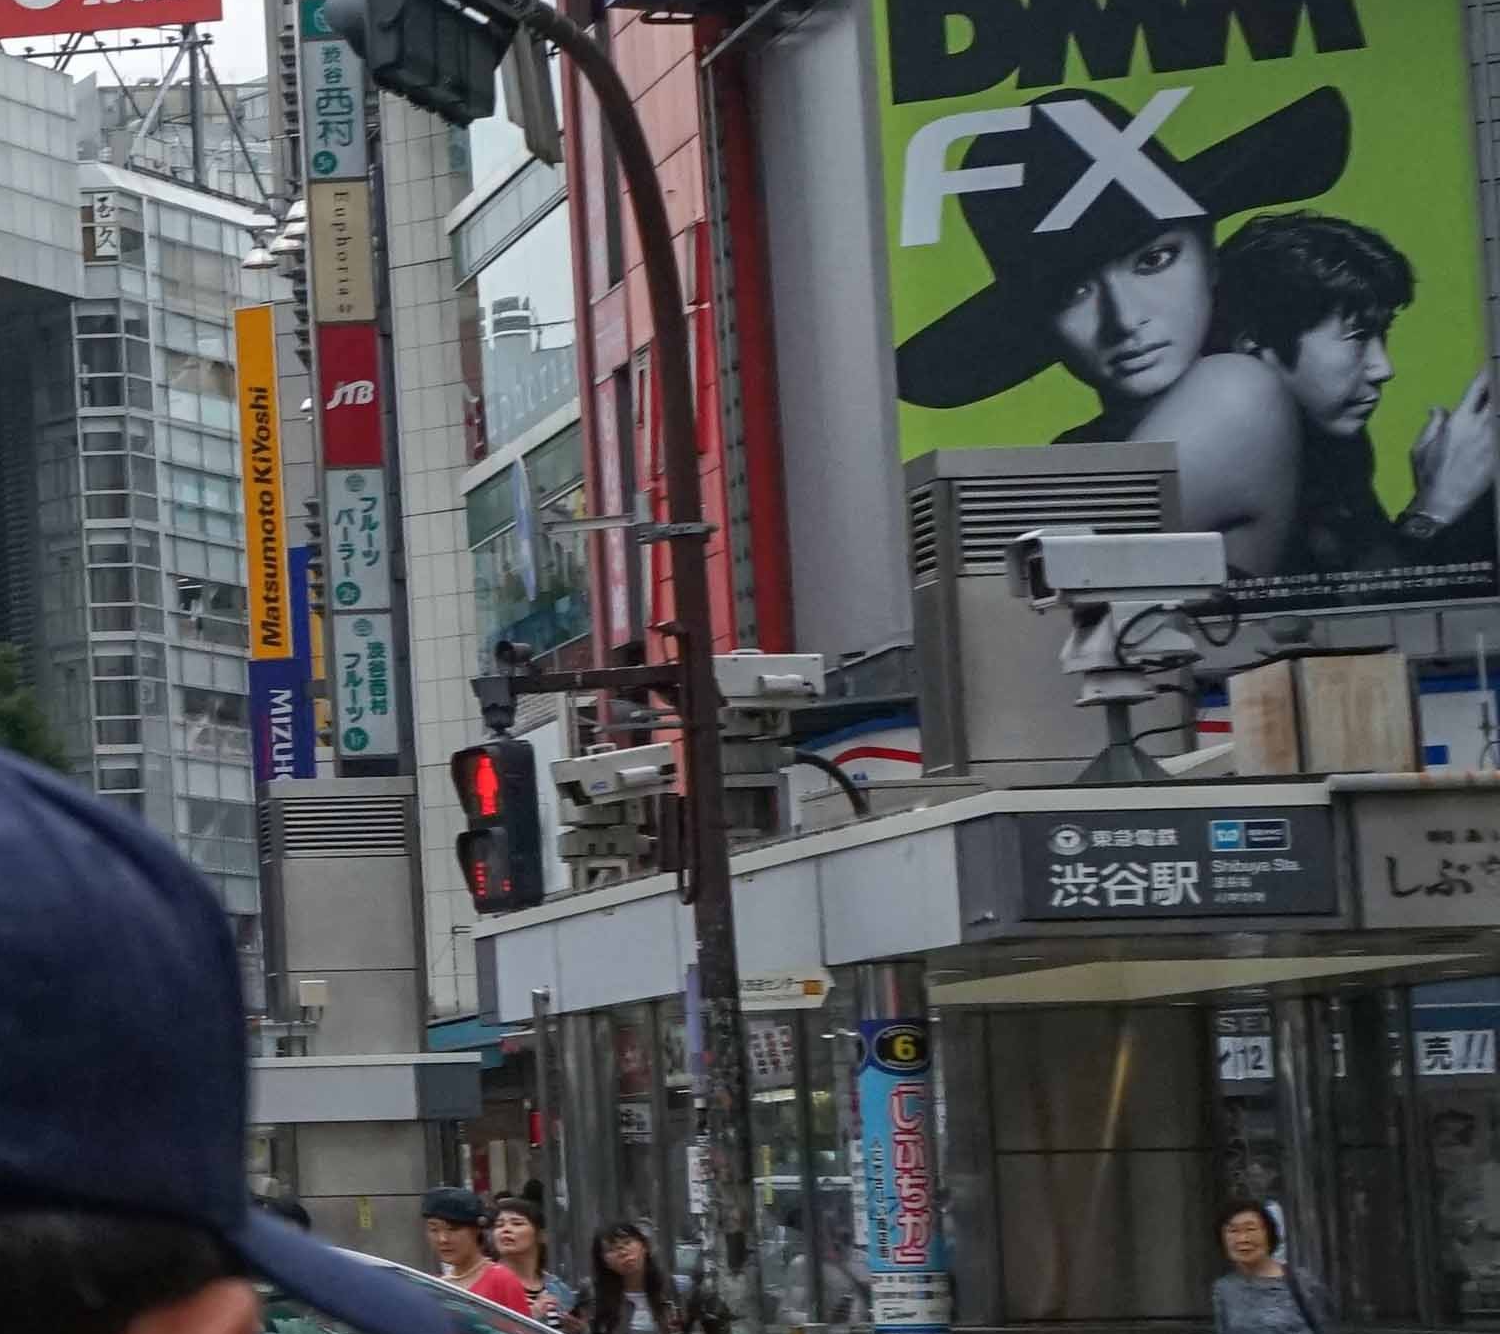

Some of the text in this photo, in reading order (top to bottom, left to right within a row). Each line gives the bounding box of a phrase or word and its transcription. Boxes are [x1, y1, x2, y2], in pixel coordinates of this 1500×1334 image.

[900, 86, 1208, 247] FX
[331, 190, 353, 297] Euphoria
[325, 379, 376, 411] JTB
[245, 385, 283, 648] Matsumoto KiYoshi
[333, 508, 356, 578] パーラー
[358, 496, 381, 567] フルーツ
[342, 652, 364, 724] フルーツ
[1091, 828, 1180, 849] 東急電鉄
[1049, 860, 1203, 908] 渋谷駅
[892, 1034, 917, 1061] 6
